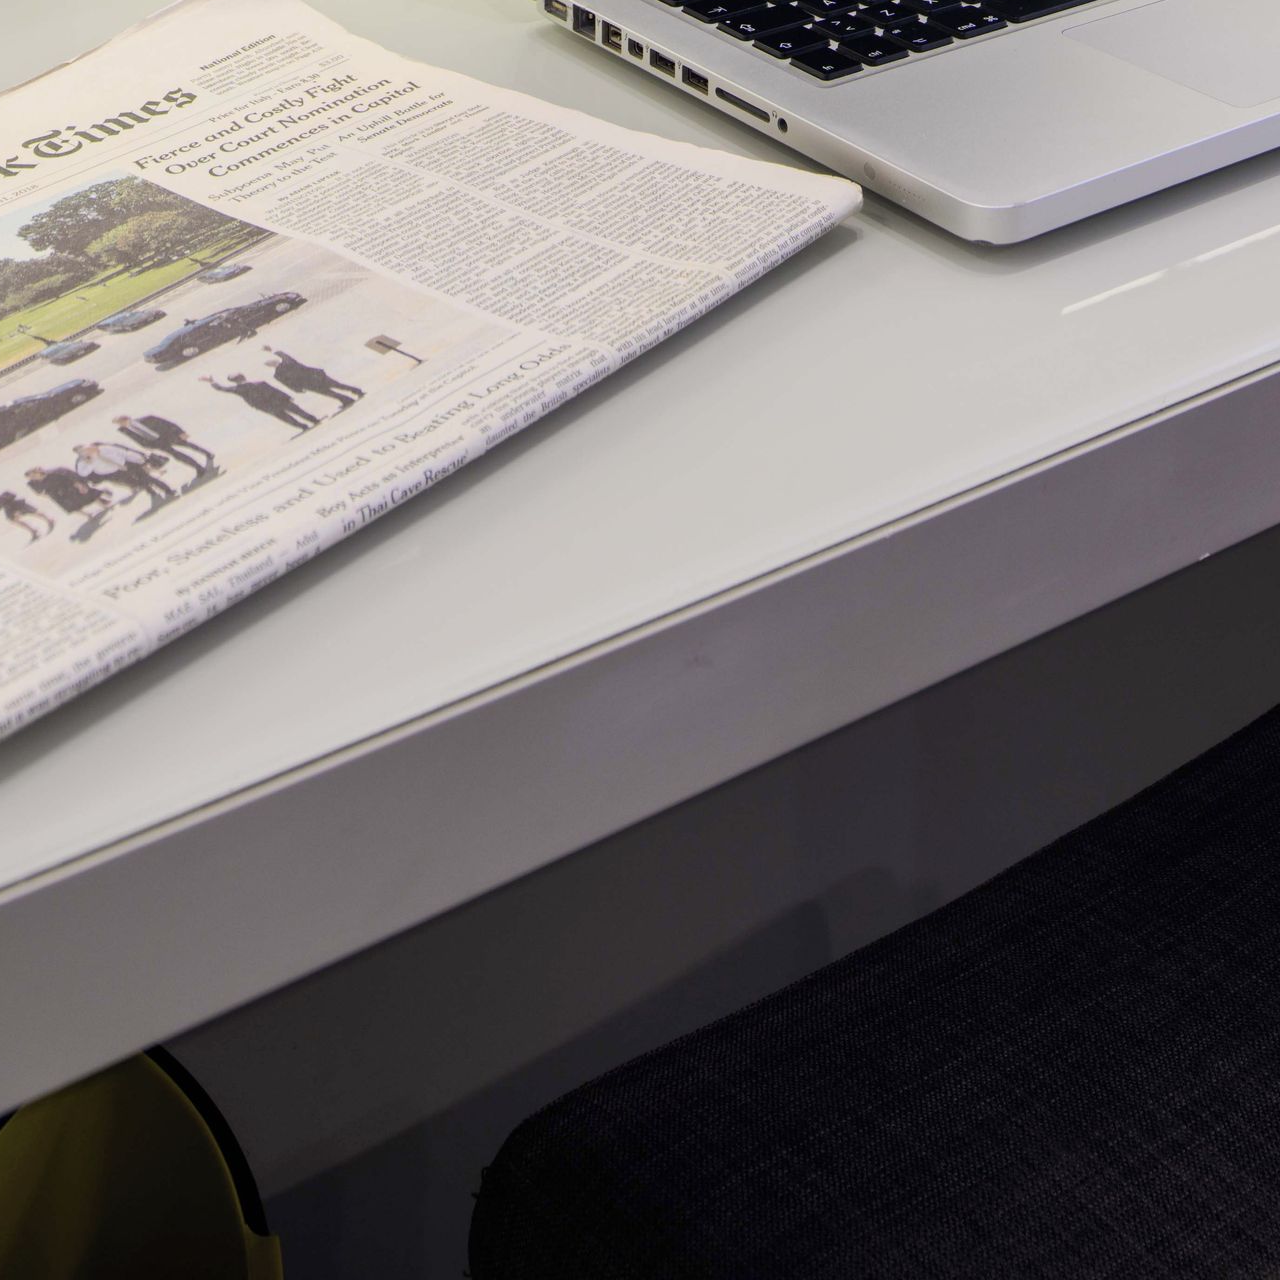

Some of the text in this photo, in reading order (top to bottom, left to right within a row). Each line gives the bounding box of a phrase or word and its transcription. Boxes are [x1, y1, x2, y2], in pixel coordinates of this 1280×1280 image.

[880, 9, 895, 17] Z
[957, 22, 976, 33] cmd
[199, 33, 276, 71] National Edition
[869, 50, 882, 58] ctrl
[22, 88, 196, 159] Times
[133, 141, 202, 170] Fierce
[204, 120, 244, 143] and
[243, 97, 305, 124] Costly
[303, 74, 358, 99] Fight
[164, 151, 217, 175] Over
[219, 126, 279, 153] Court
[277, 79, 391, 129] Nomination
[207, 110, 235, 123] Price
[232, 103, 250, 113] for
[247, 95, 273, 106] Italy
[275, 81, 302, 94] Euro
[208, 81, 421, 177] Commences in Capitol
[337, 91, 445, 143] An Uphill Battle for
[356, 99, 454, 144] Senate Democrats
[207, 143, 331, 202] Subpoena May Put
[227, 151, 337, 203] Theory to the Test
[733, 211, 838, 280] mation fights, but the coming bat-
[615, 282, 731, 353] with his lead lawyer at the time,
[485, 365, 612, 448] daunted the British specialists
[500, 389, 547, 422] underwater
[555, 369, 583, 389] matrix
[589, 353, 609, 369] that
[102, 344, 572, 601] Poor, Stateless and Used to Beating Long Odds
[316, 434, 465, 519] Boy Acts as Interpreter
[342, 455, 473, 535] in Thai Cave Rescue'
[228, 555, 275, 589] Thailand
